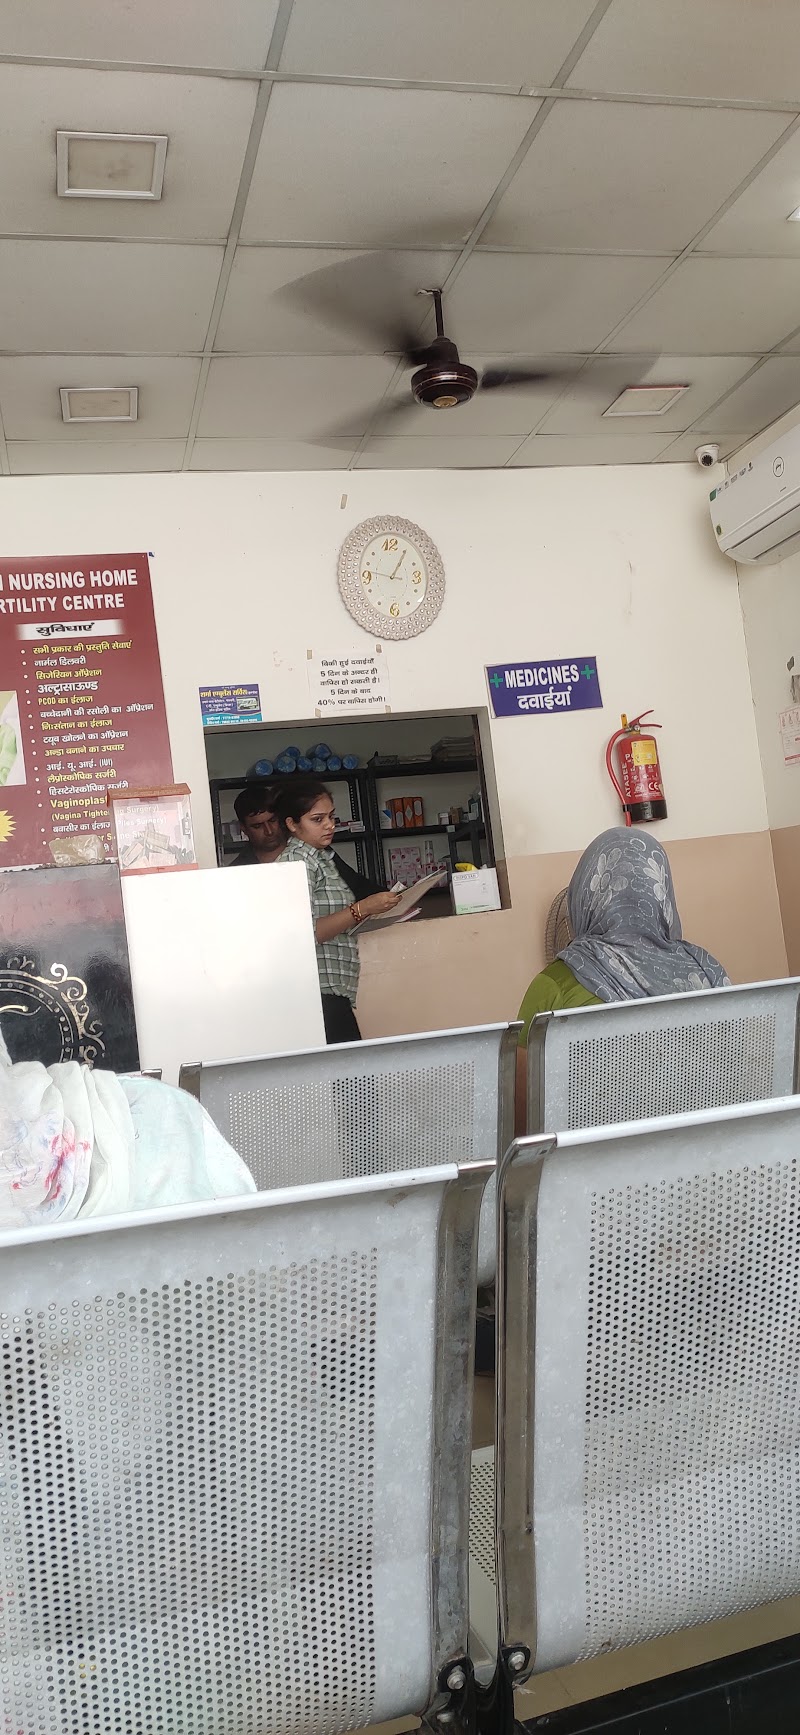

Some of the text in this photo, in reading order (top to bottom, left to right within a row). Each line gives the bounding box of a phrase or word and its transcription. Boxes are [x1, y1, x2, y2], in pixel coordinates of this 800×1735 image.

[381, 538, 398, 551] 12
[8, 571, 85, 591] NURSING
[89, 569, 138, 587] HOME
[362, 570, 372, 585] 9
[412, 570, 421, 585] 3
[62, 593, 125, 611] CENTRE
[389, 602, 400, 617] 6
[36, 622, 95, 636] सुविधाएं
[33, 644, 49, 654] सभी
[51, 645, 72, 654] प्रकार
[73, 642, 84, 652] की
[34, 656, 57, 667] नार्मल
[327, 669, 340, 677] दिन
[504, 664, 580, 689] MEDICINES
[38, 694, 93, 705] PCOD का ईलाज
[516, 685, 572, 710] दवाईयां
[74, 706, 85, 716] की
[111, 705, 122, 713] का
[77, 720, 88, 728] का
[90, 718, 113, 727] ईलाज
[88, 732, 98, 740] का
[88, 745, 99, 753] का
[95, 769, 117, 779] सर्जरी
[648, 782, 659, 791] CE
[50, 795, 108, 809] Vaginoplast
[51, 812, 81, 822] (Vagina
[80, 823, 90, 831] का
